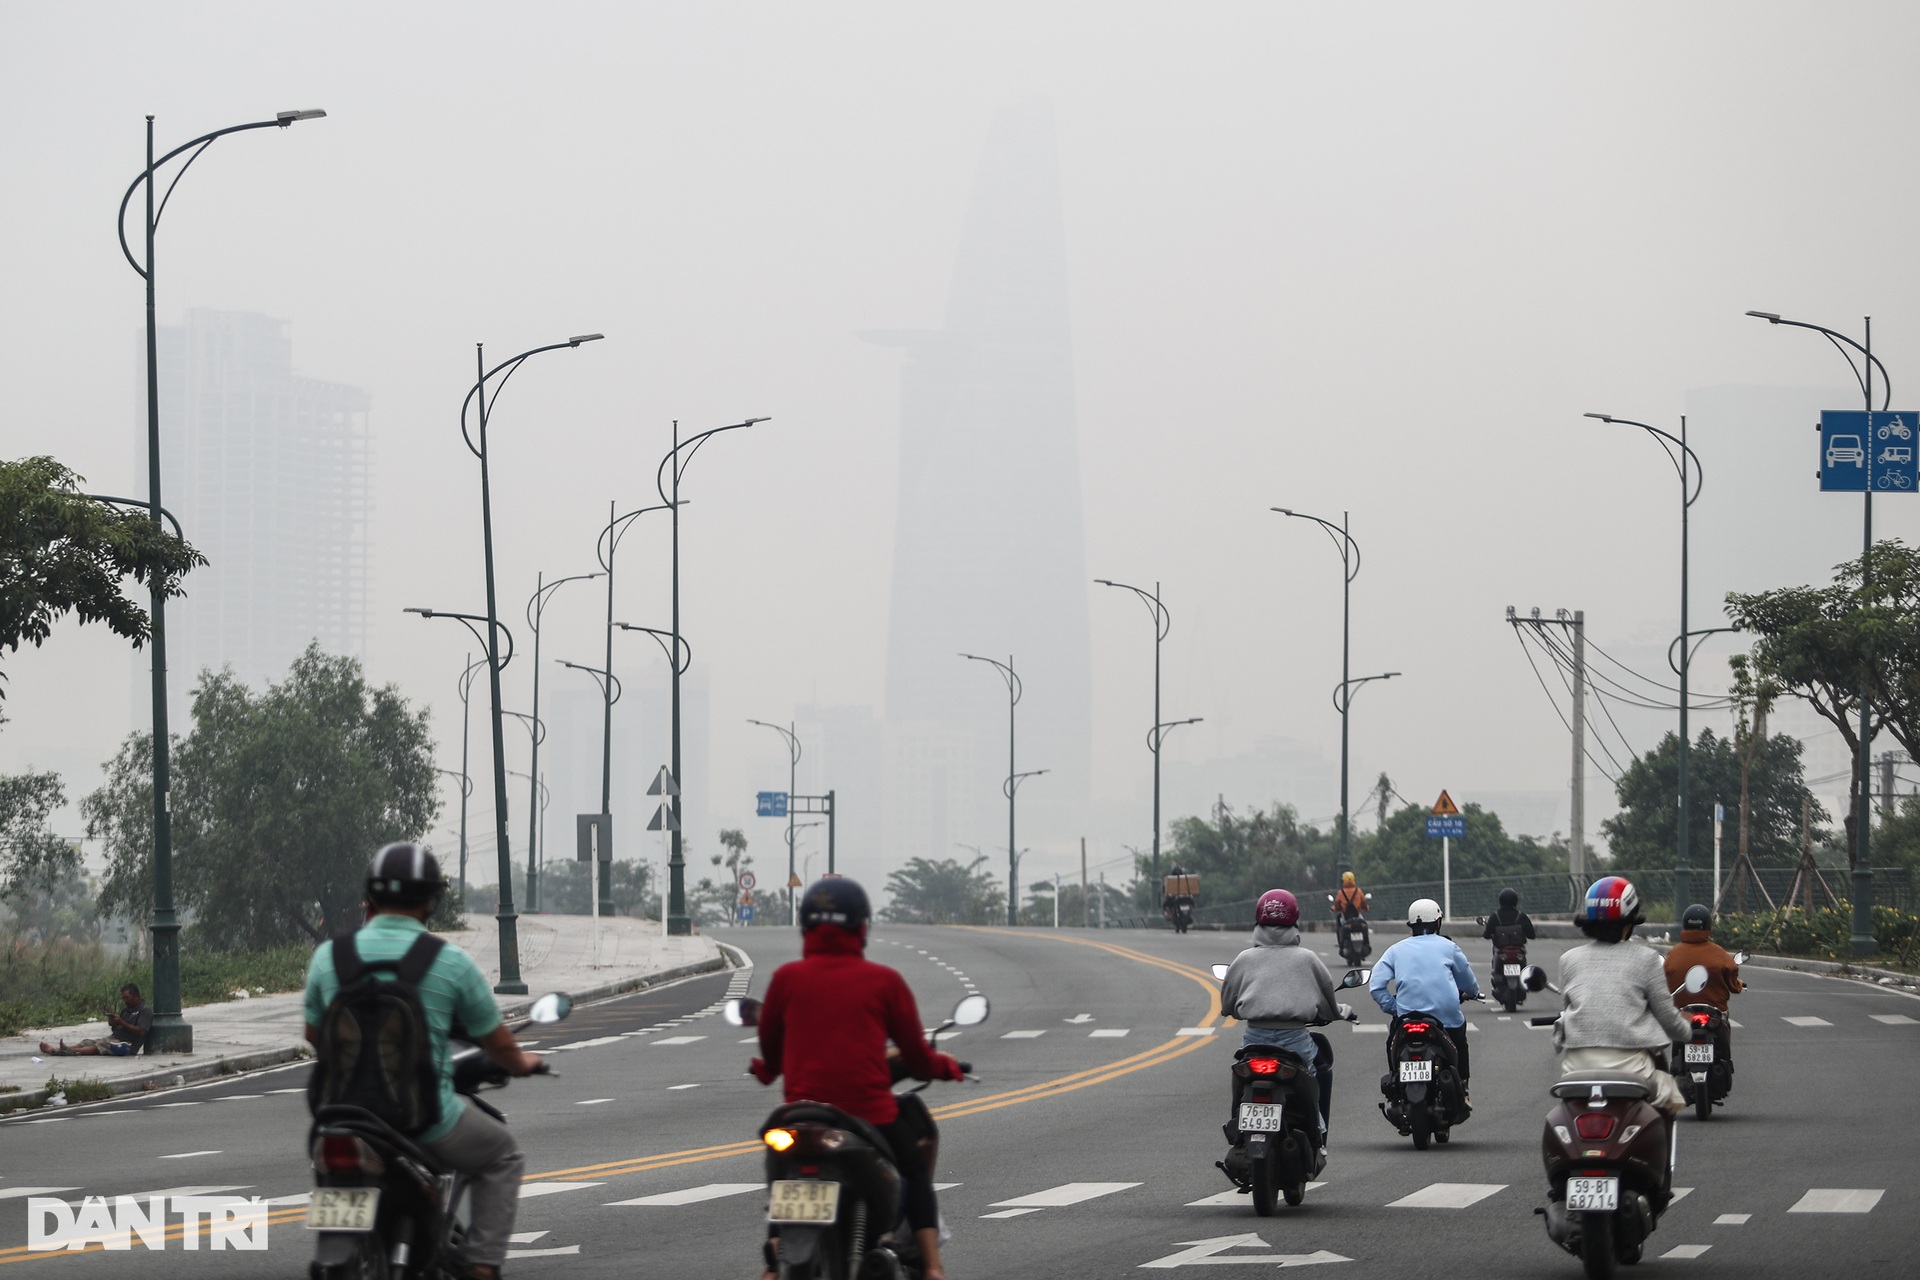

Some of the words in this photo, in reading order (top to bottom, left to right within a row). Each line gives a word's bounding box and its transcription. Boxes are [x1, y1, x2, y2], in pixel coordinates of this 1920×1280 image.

[743, 908, 750, 918] P
[1401, 1071, 1430, 1081] 211.08
[1241, 1117, 1279, 1130] 549.39
[1575, 1180, 1609, 1194] 59-B1
[1569, 1194, 1615, 1209] 587.14
